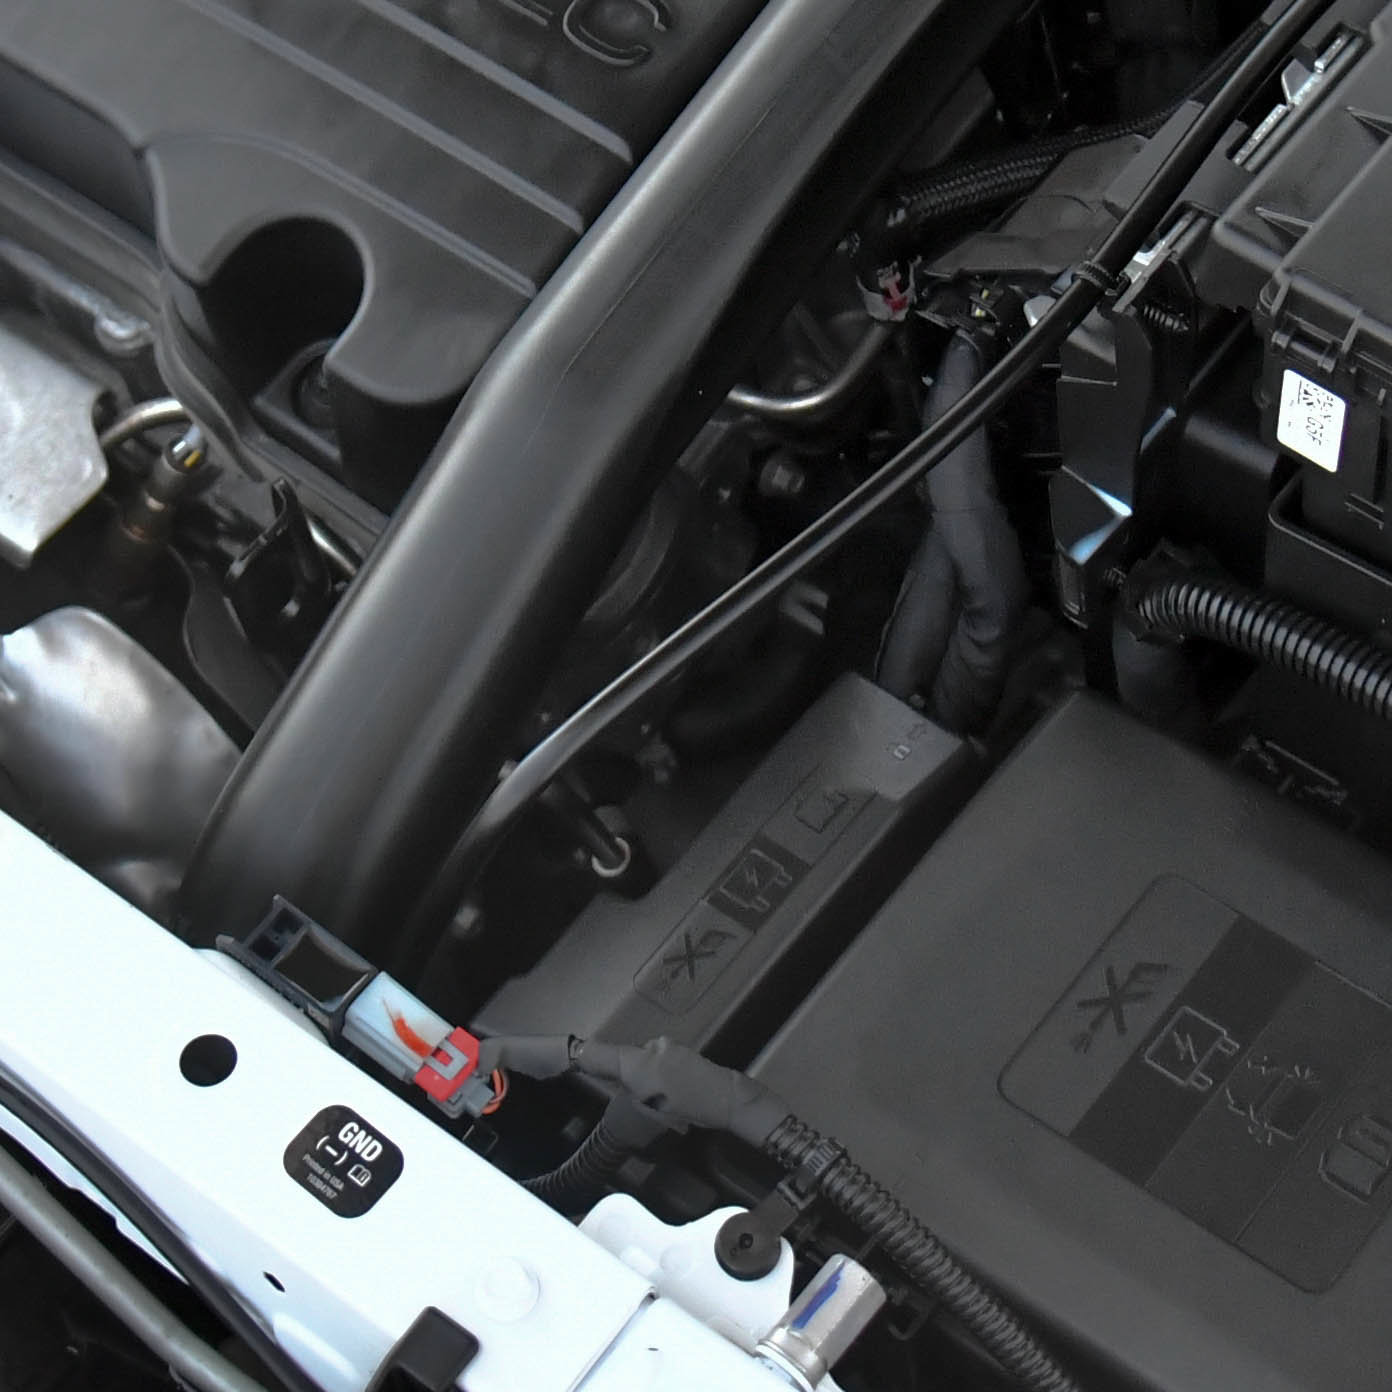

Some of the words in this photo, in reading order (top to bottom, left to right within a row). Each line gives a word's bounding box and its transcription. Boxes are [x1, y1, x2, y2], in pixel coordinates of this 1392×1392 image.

[338, 1121, 384, 1163] GND
[302, 1153, 325, 1175] Printed
[328, 1174, 346, 1193] USA
